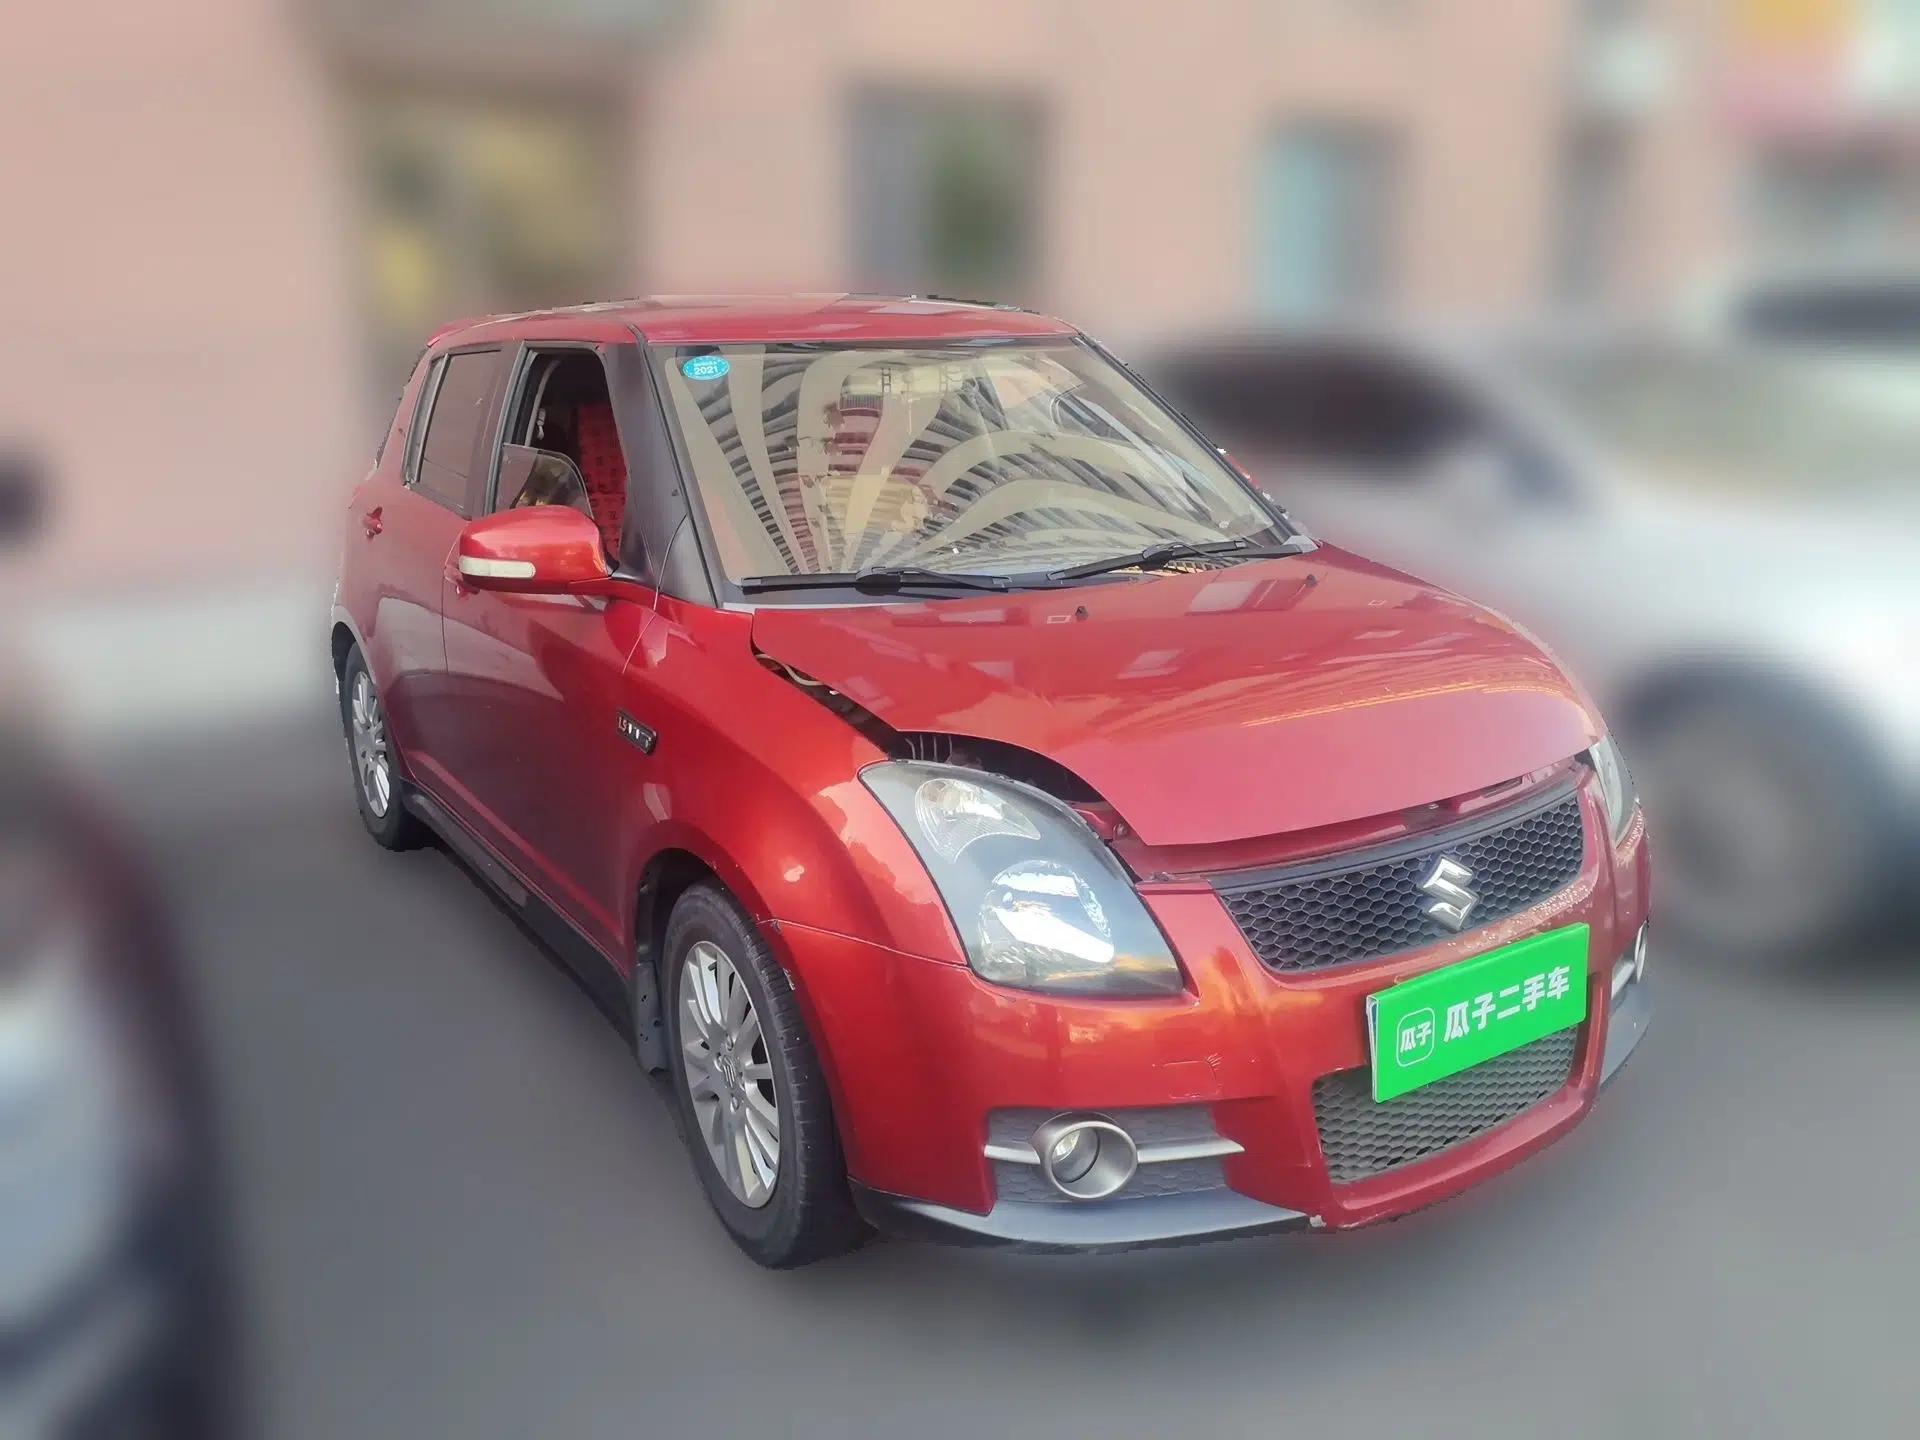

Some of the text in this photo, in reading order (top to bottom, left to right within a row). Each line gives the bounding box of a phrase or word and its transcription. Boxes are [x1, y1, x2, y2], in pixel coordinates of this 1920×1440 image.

[694, 365, 719, 376] 2021
[1443, 966, 1571, 1042] 瓜子二手车
[1399, 1021, 1433, 1053] 瓜子
